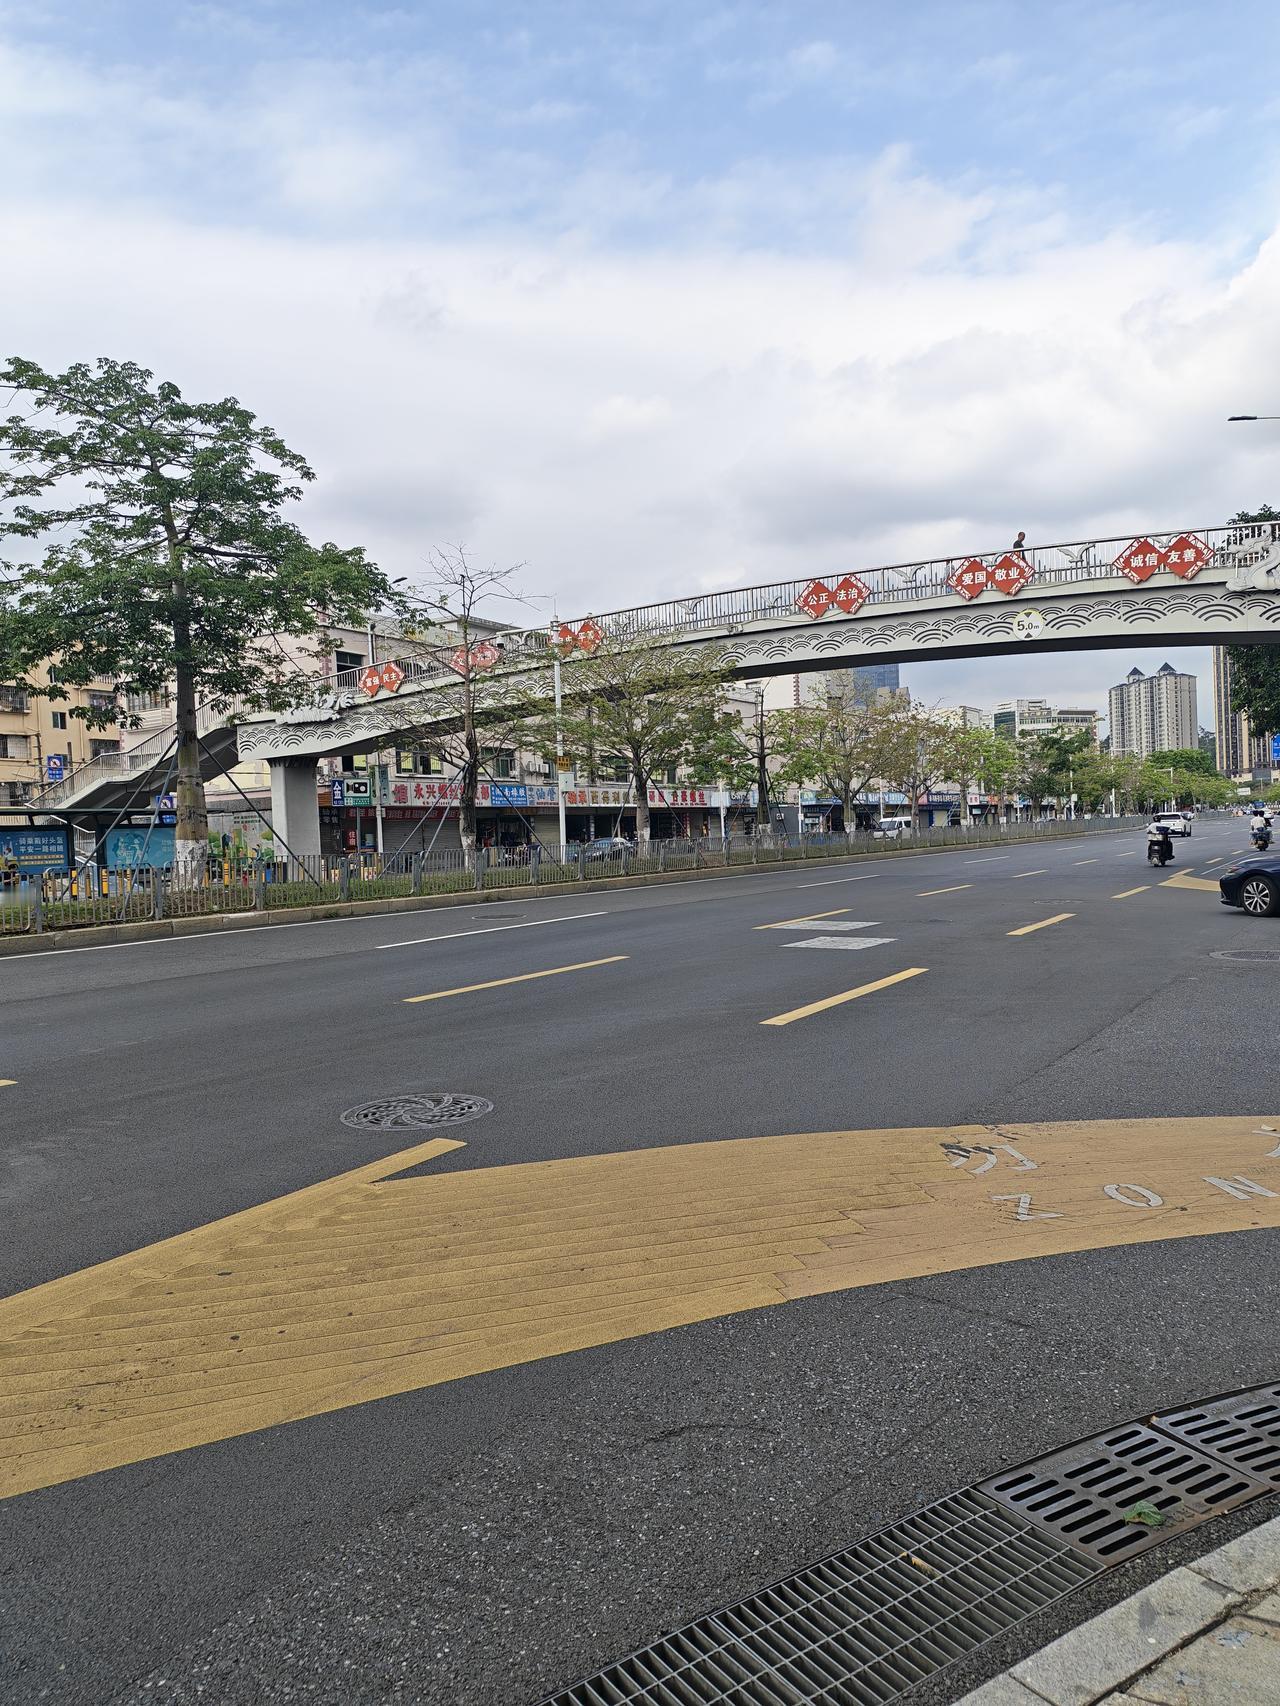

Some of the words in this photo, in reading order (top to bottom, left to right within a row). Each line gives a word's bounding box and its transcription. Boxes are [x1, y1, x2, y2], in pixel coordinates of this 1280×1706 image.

[1130, 553, 1158, 568] 诚信
[1167, 548, 1196, 563] 友善
[962, 571, 986, 585] 爱国
[995, 567, 1020, 581] 敬业
[808, 592, 829, 605] 公正
[837, 587, 858, 601] 法治
[366, 675, 380, 687] 富强
[383, 672, 398, 683] 民主
